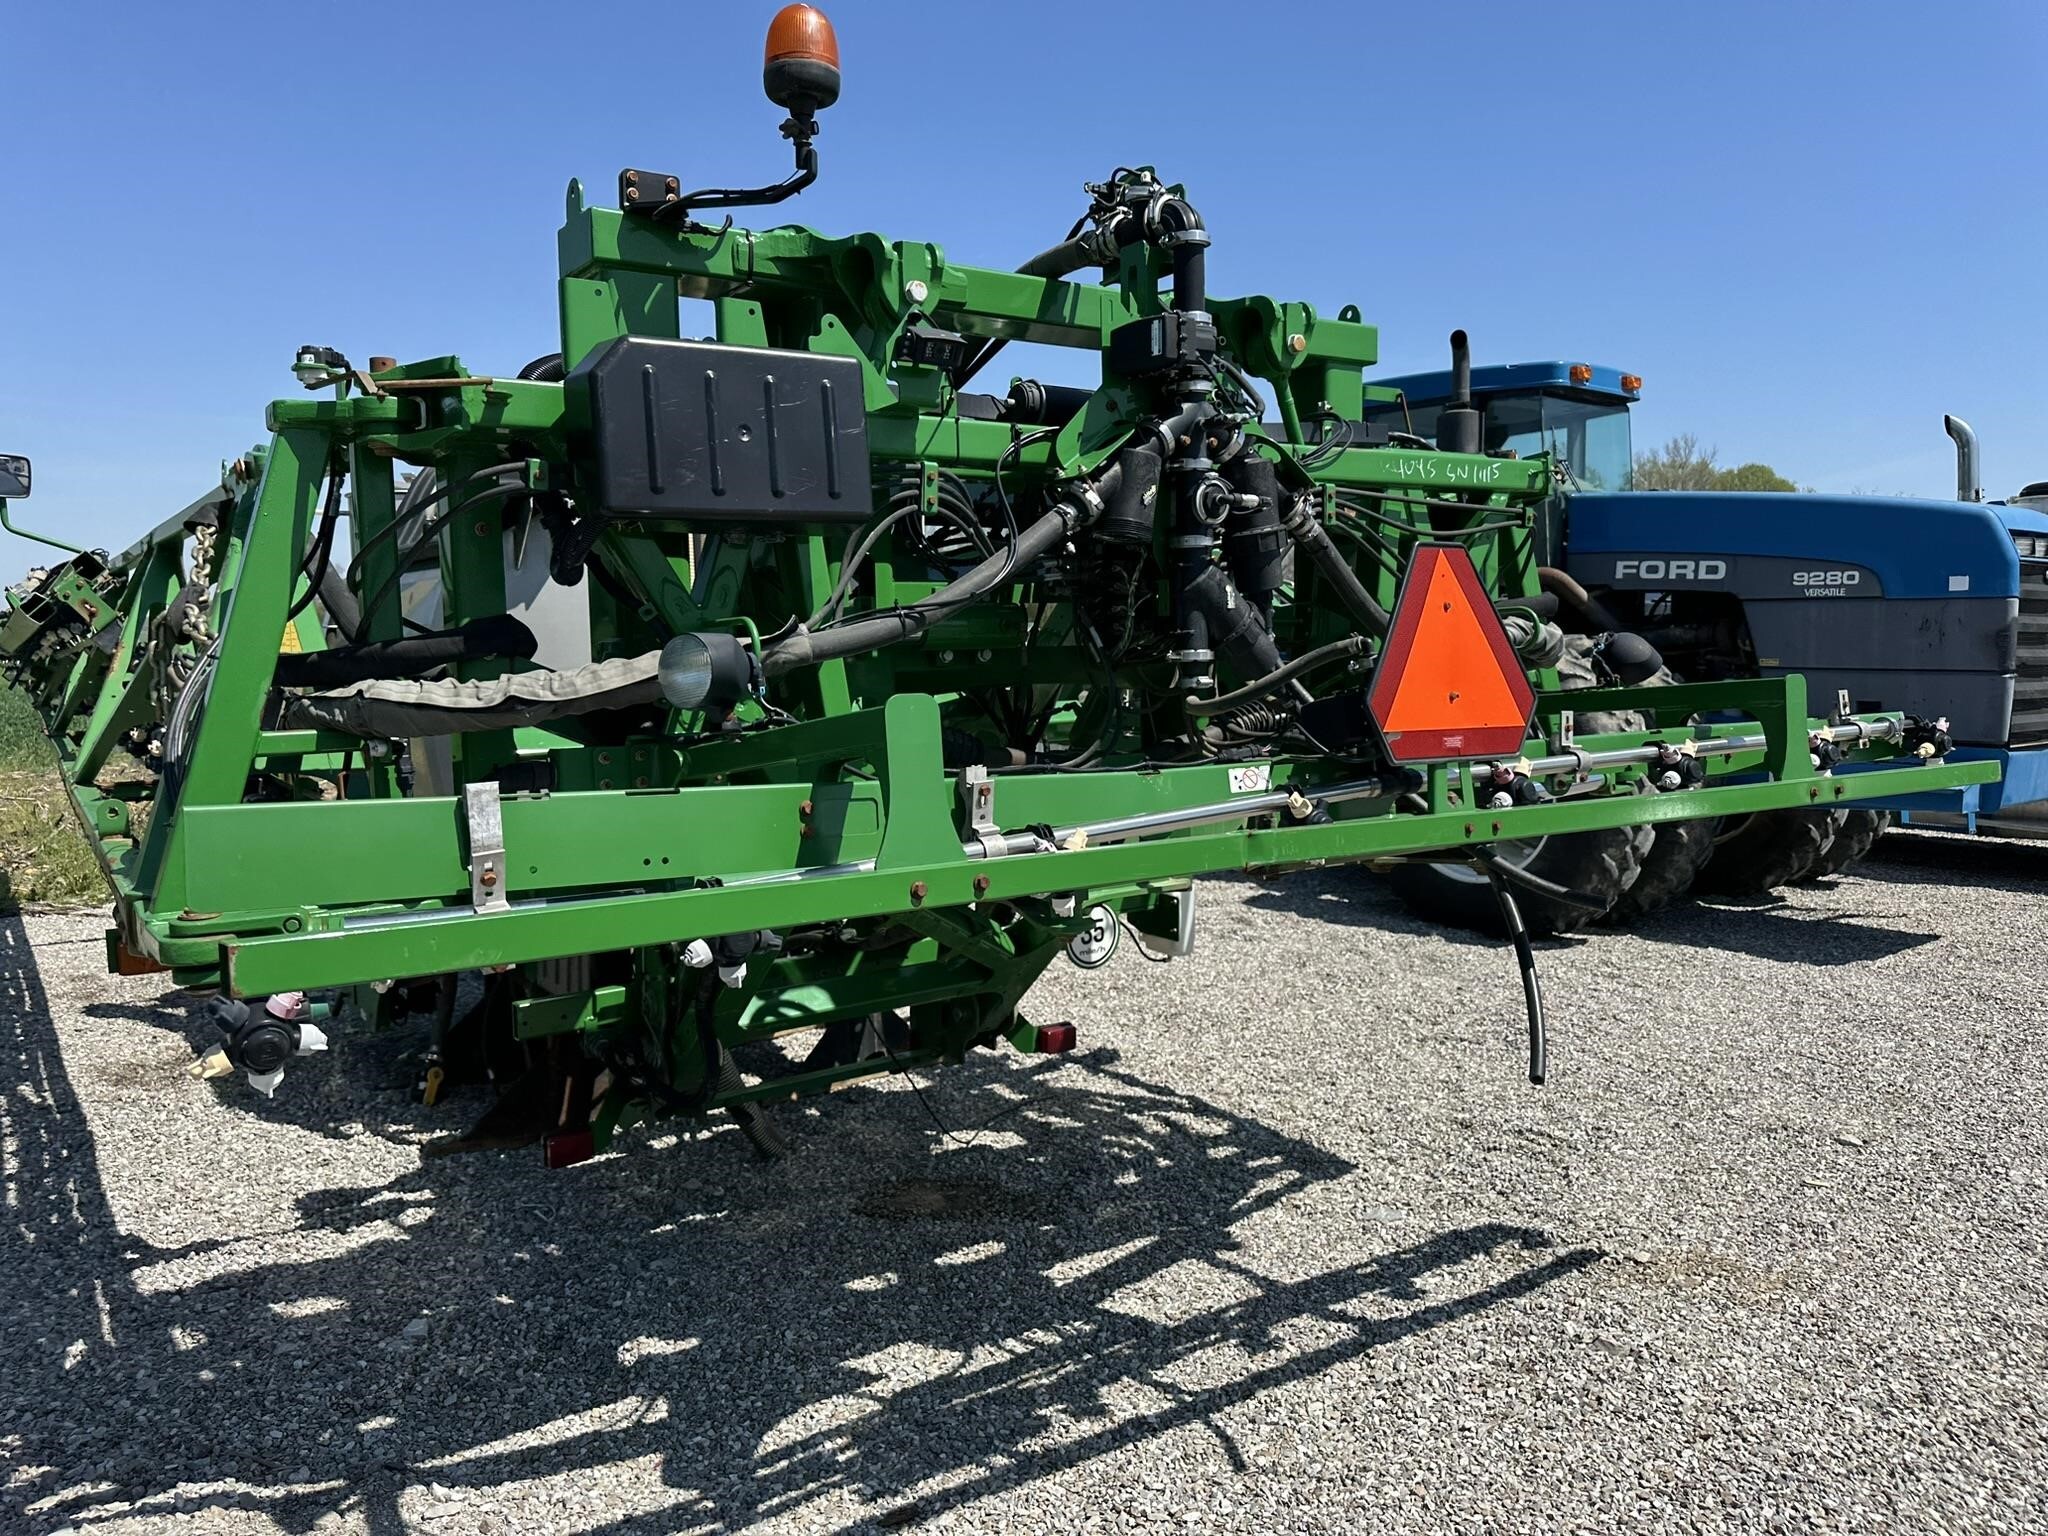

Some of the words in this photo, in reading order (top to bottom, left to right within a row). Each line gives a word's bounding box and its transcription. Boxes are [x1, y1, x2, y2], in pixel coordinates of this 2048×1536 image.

[1446, 463, 1468, 482] SN
[1614, 560, 1727, 580] FORD
[1792, 571, 1860, 586] 9280
[1804, 587, 1846, 597] VERSATILE
